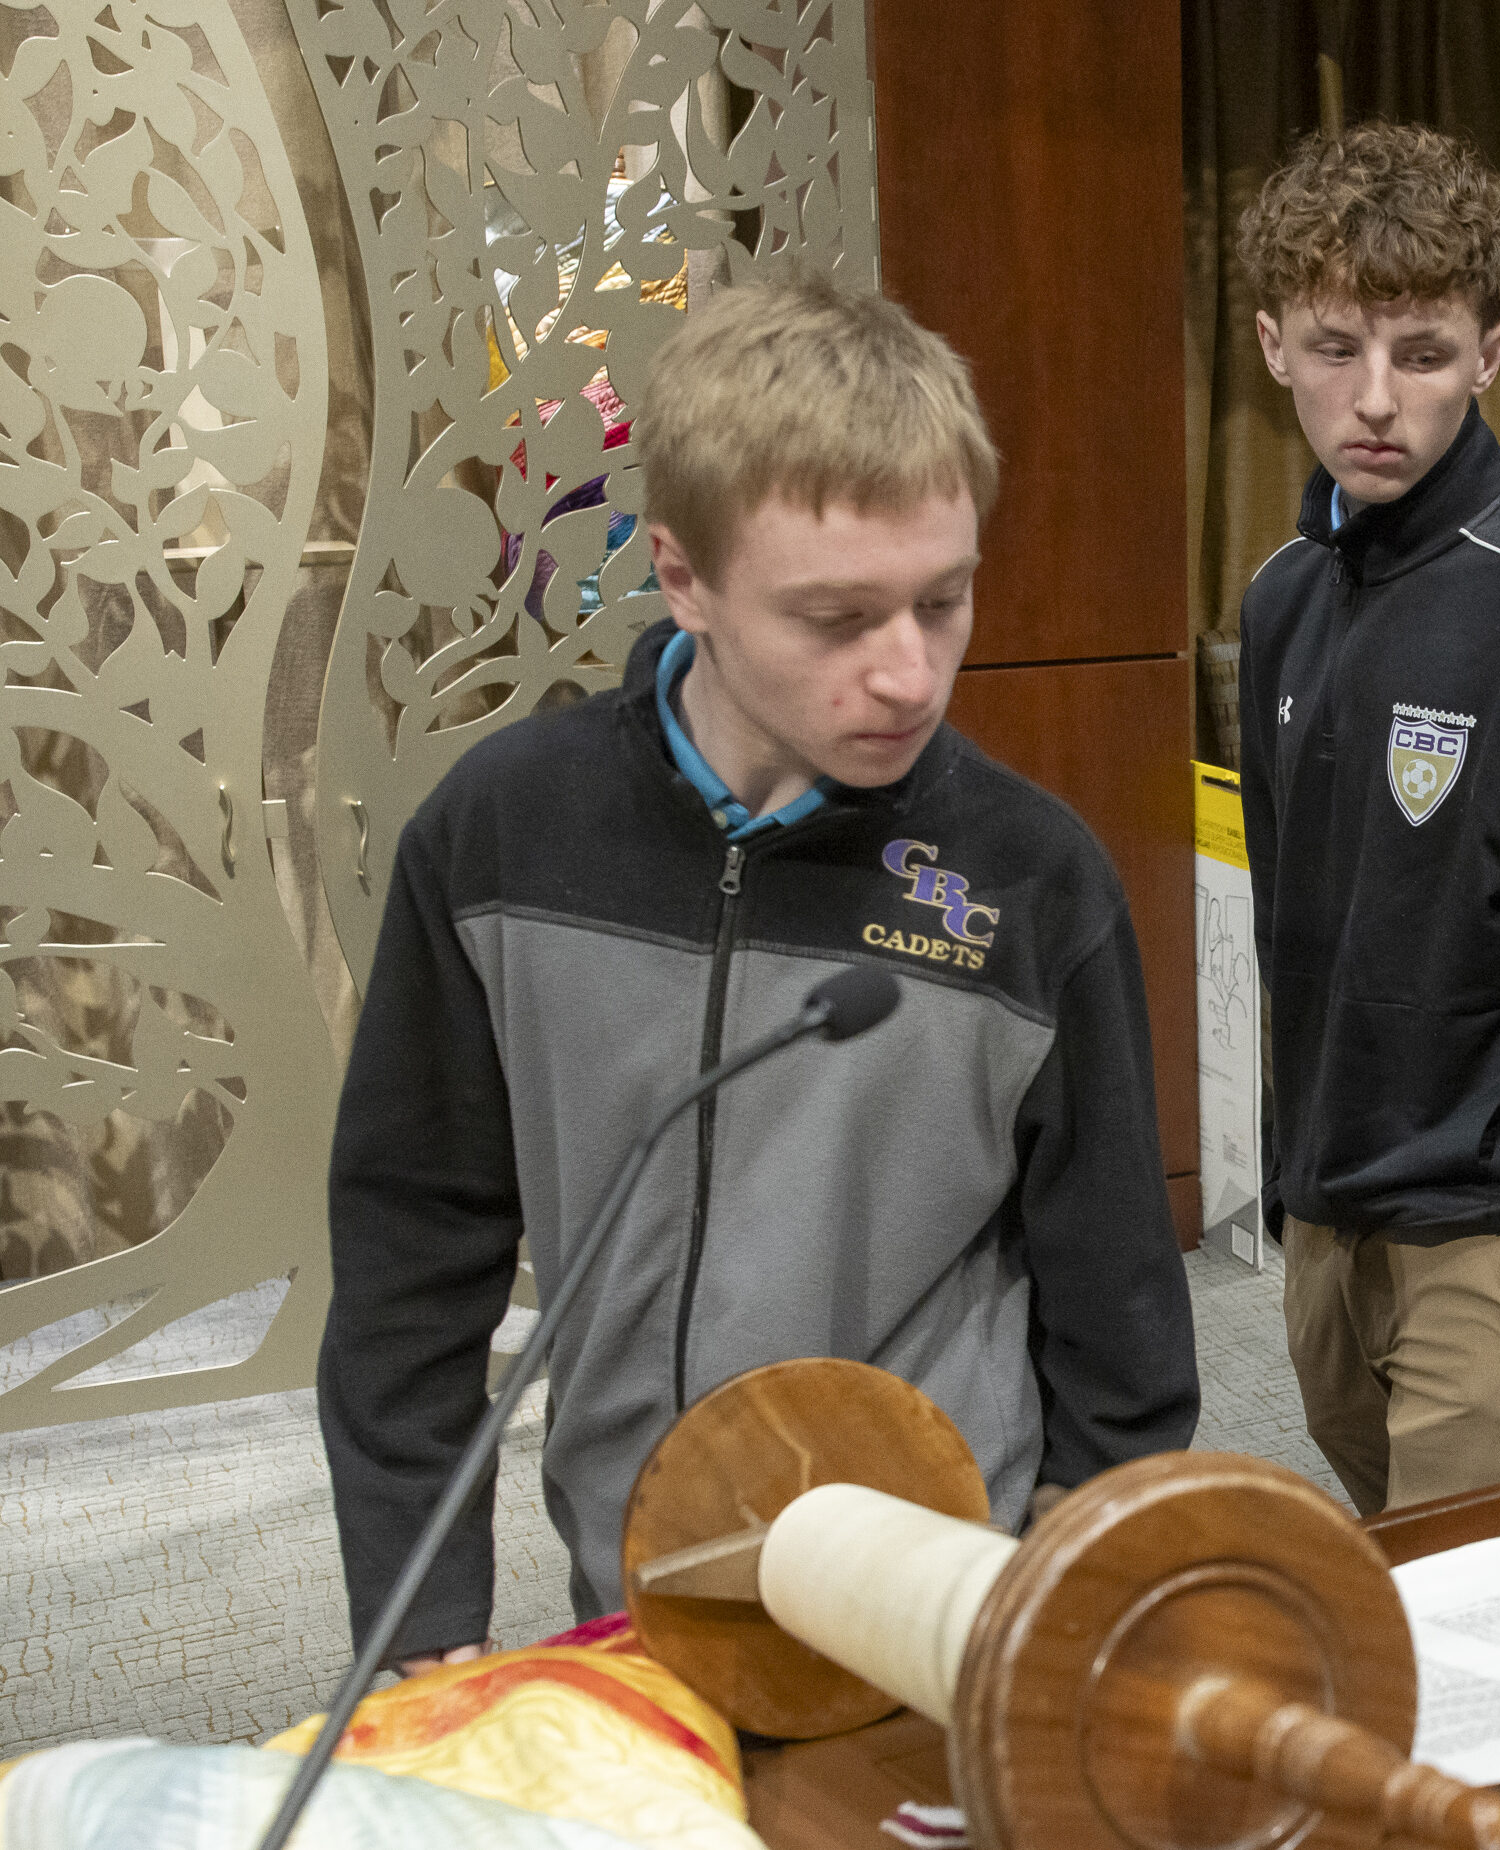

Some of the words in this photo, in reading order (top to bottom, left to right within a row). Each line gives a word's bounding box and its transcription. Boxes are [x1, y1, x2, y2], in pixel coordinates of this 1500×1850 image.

[1395, 729, 1459, 756] CBC
[881, 839, 1000, 948] CBC
[862, 923, 986, 970] CADETS
